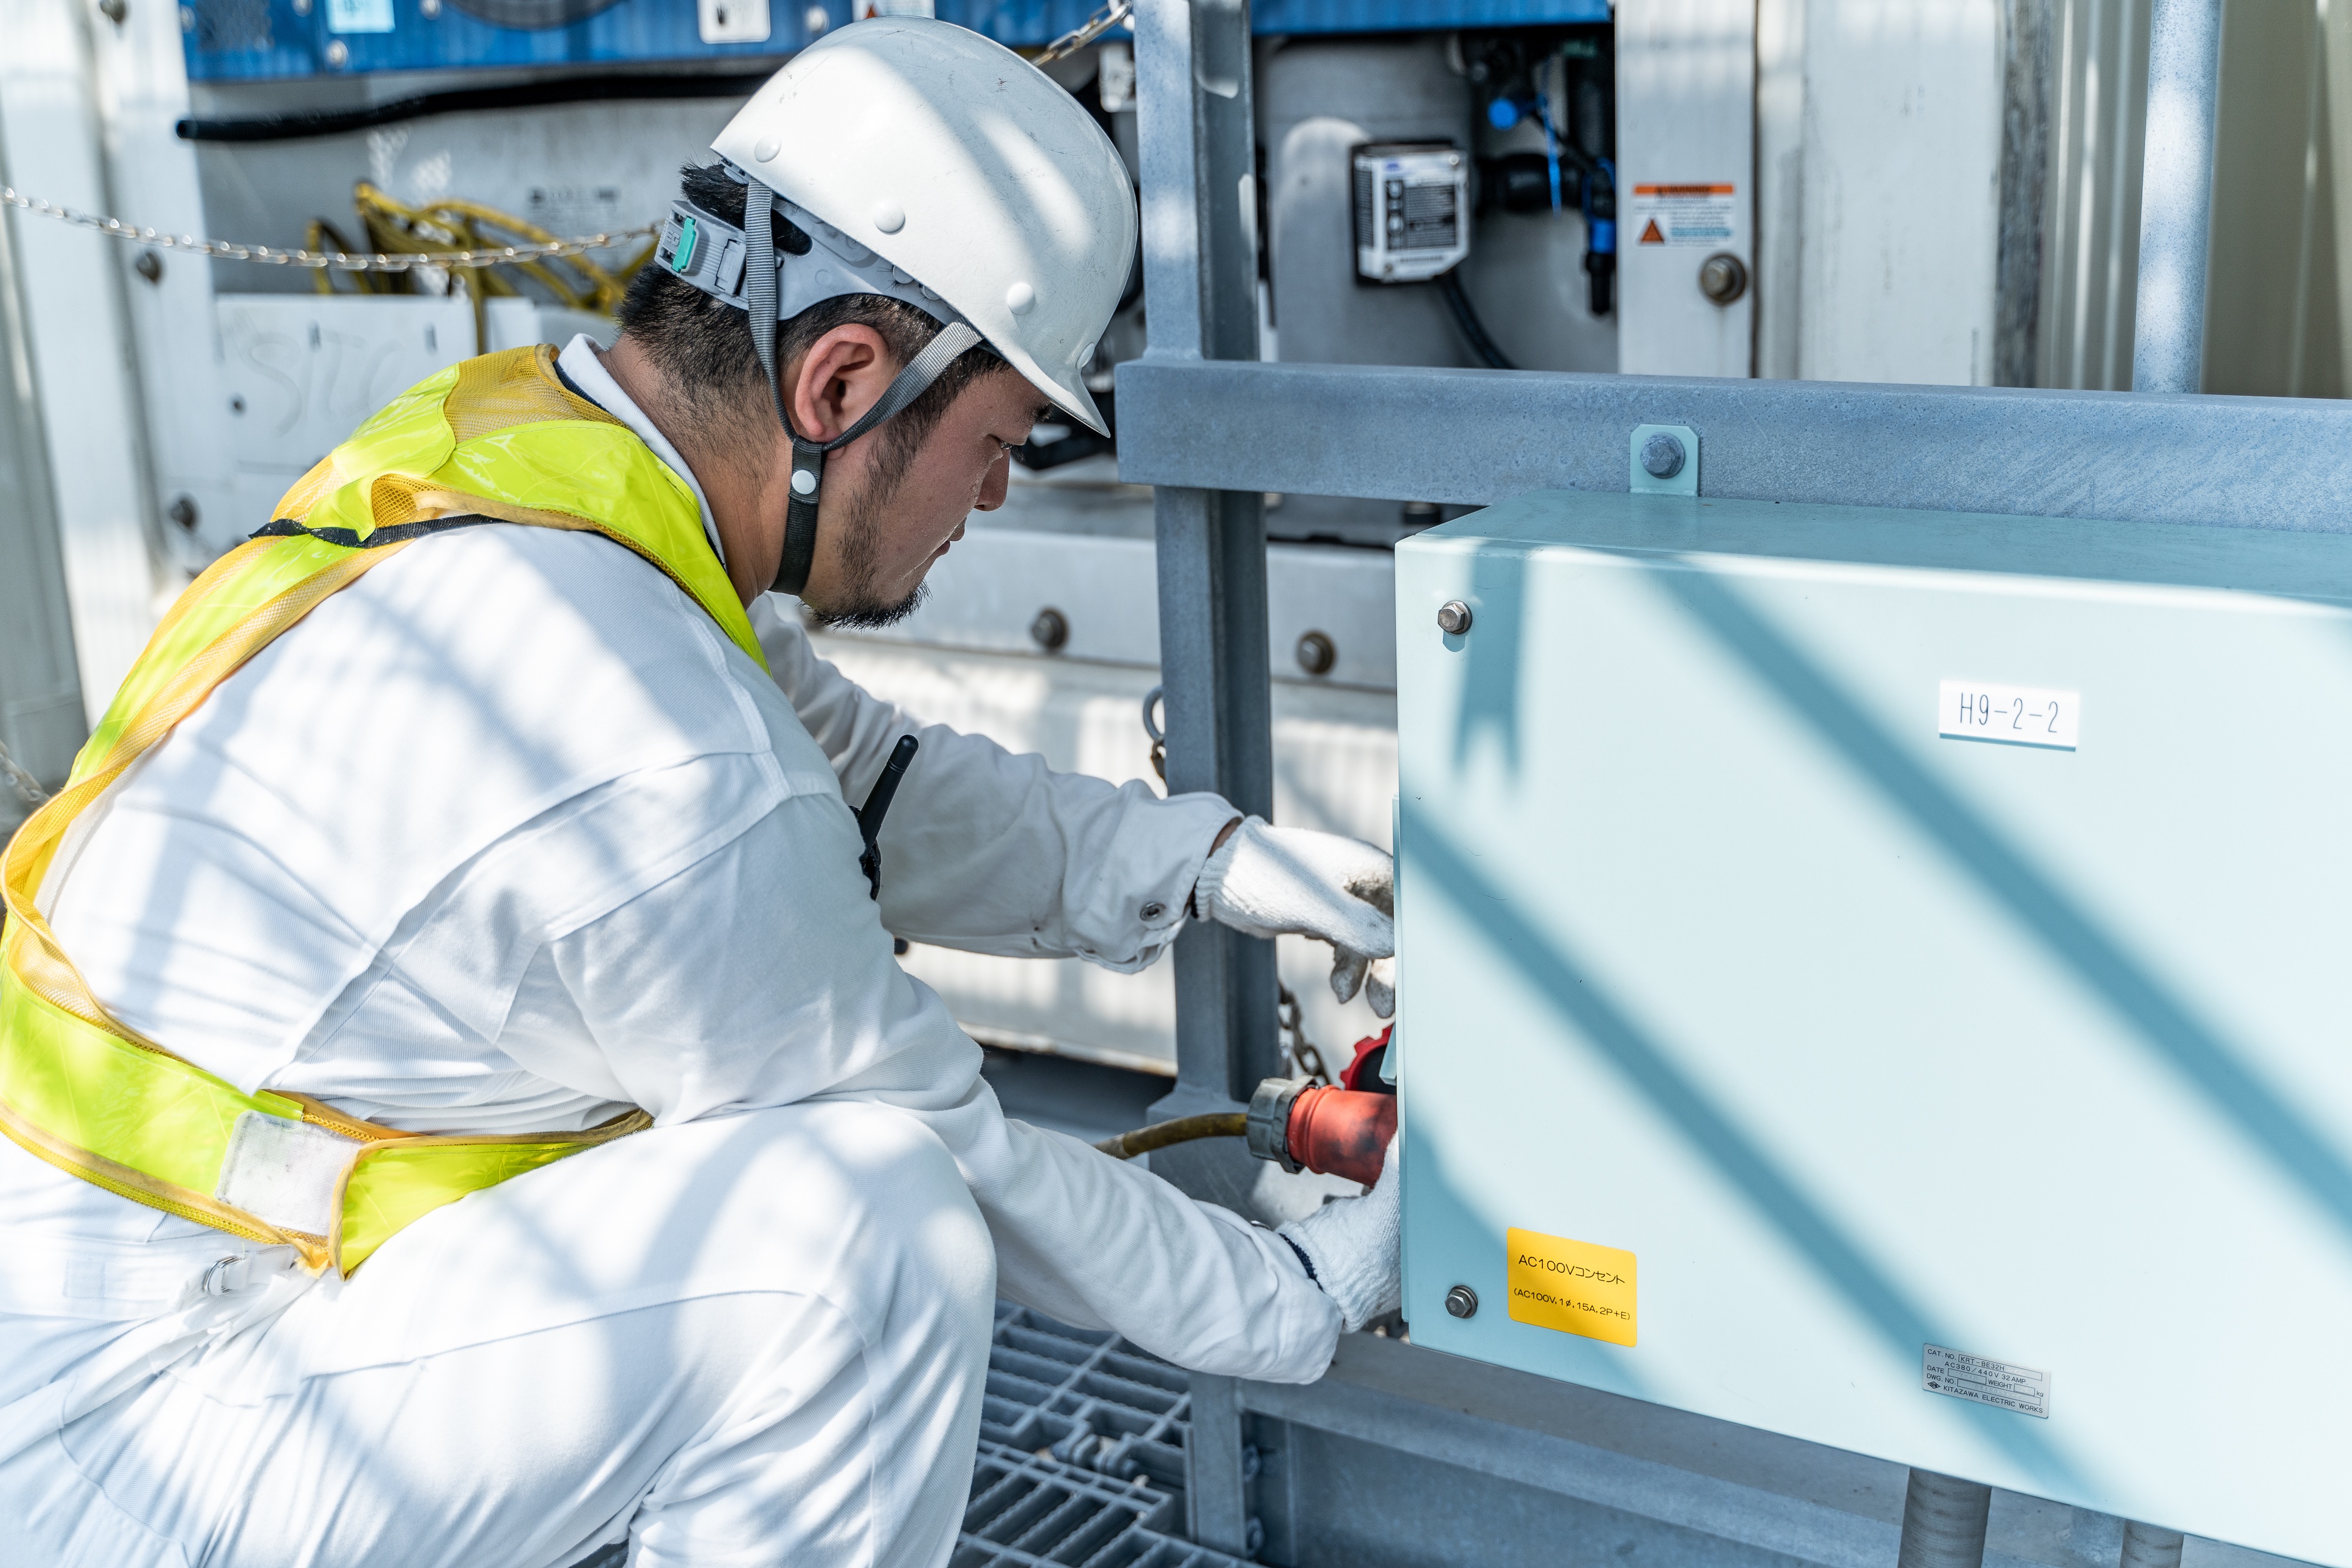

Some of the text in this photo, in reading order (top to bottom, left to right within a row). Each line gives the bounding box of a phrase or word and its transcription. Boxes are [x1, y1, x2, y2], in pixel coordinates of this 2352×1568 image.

[1960, 692, 2058, 733] H9-2-2
[1518, 1254, 1625, 1285] AC100Vコンセント
[1927, 1365, 1945, 1374] DATE
[1988, 1379, 2013, 1389] WEIGHT
[1945, 1377, 1956, 1385] NO.
[1943, 1385, 1979, 1399] KITAZAWA
[1982, 1394, 2016, 1407] ELECTRIC
[2019, 1403, 2043, 1413] WORKS
